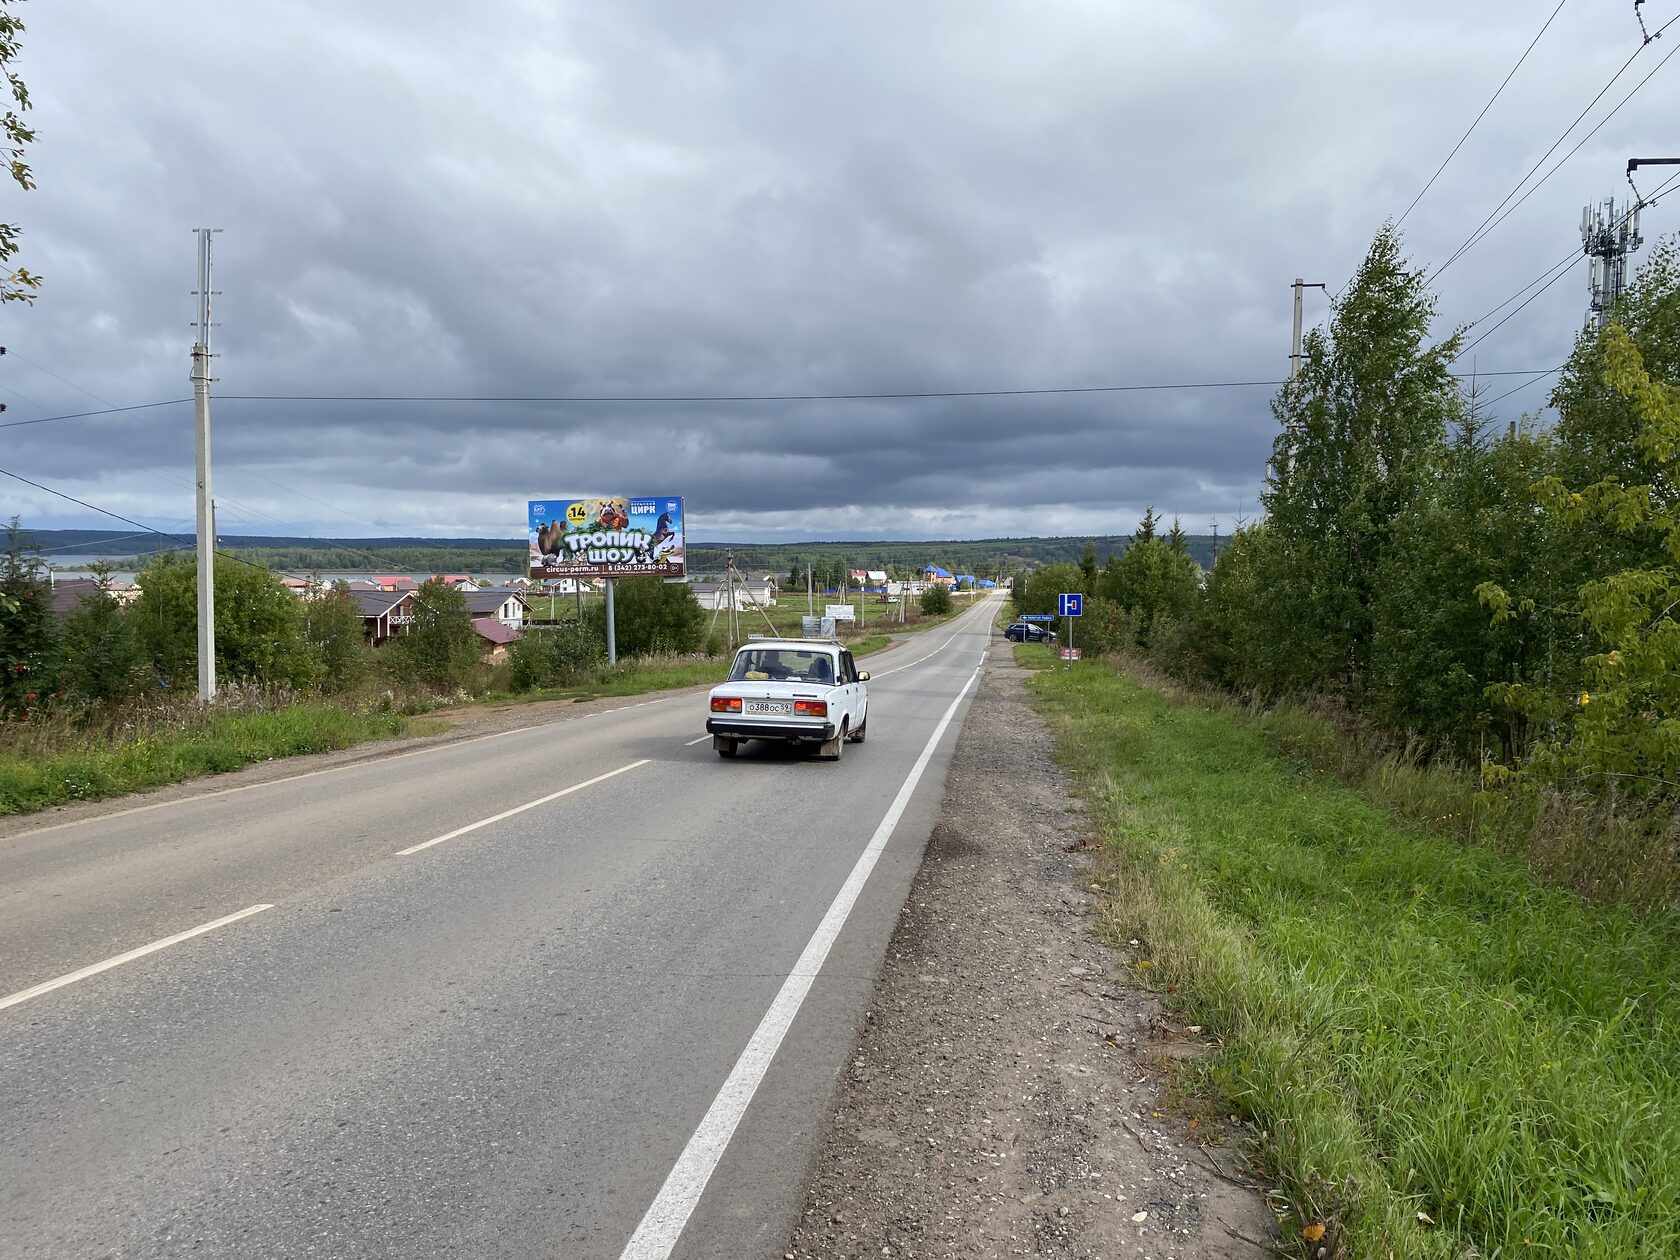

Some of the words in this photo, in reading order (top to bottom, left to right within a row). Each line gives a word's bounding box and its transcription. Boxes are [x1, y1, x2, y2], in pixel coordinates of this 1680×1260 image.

[571, 507, 586, 517] 14
[631, 506, 656, 515] ЦИРК
[564, 531, 650, 551] ТРОПИК
[588, 548, 634, 562] ШОУ
